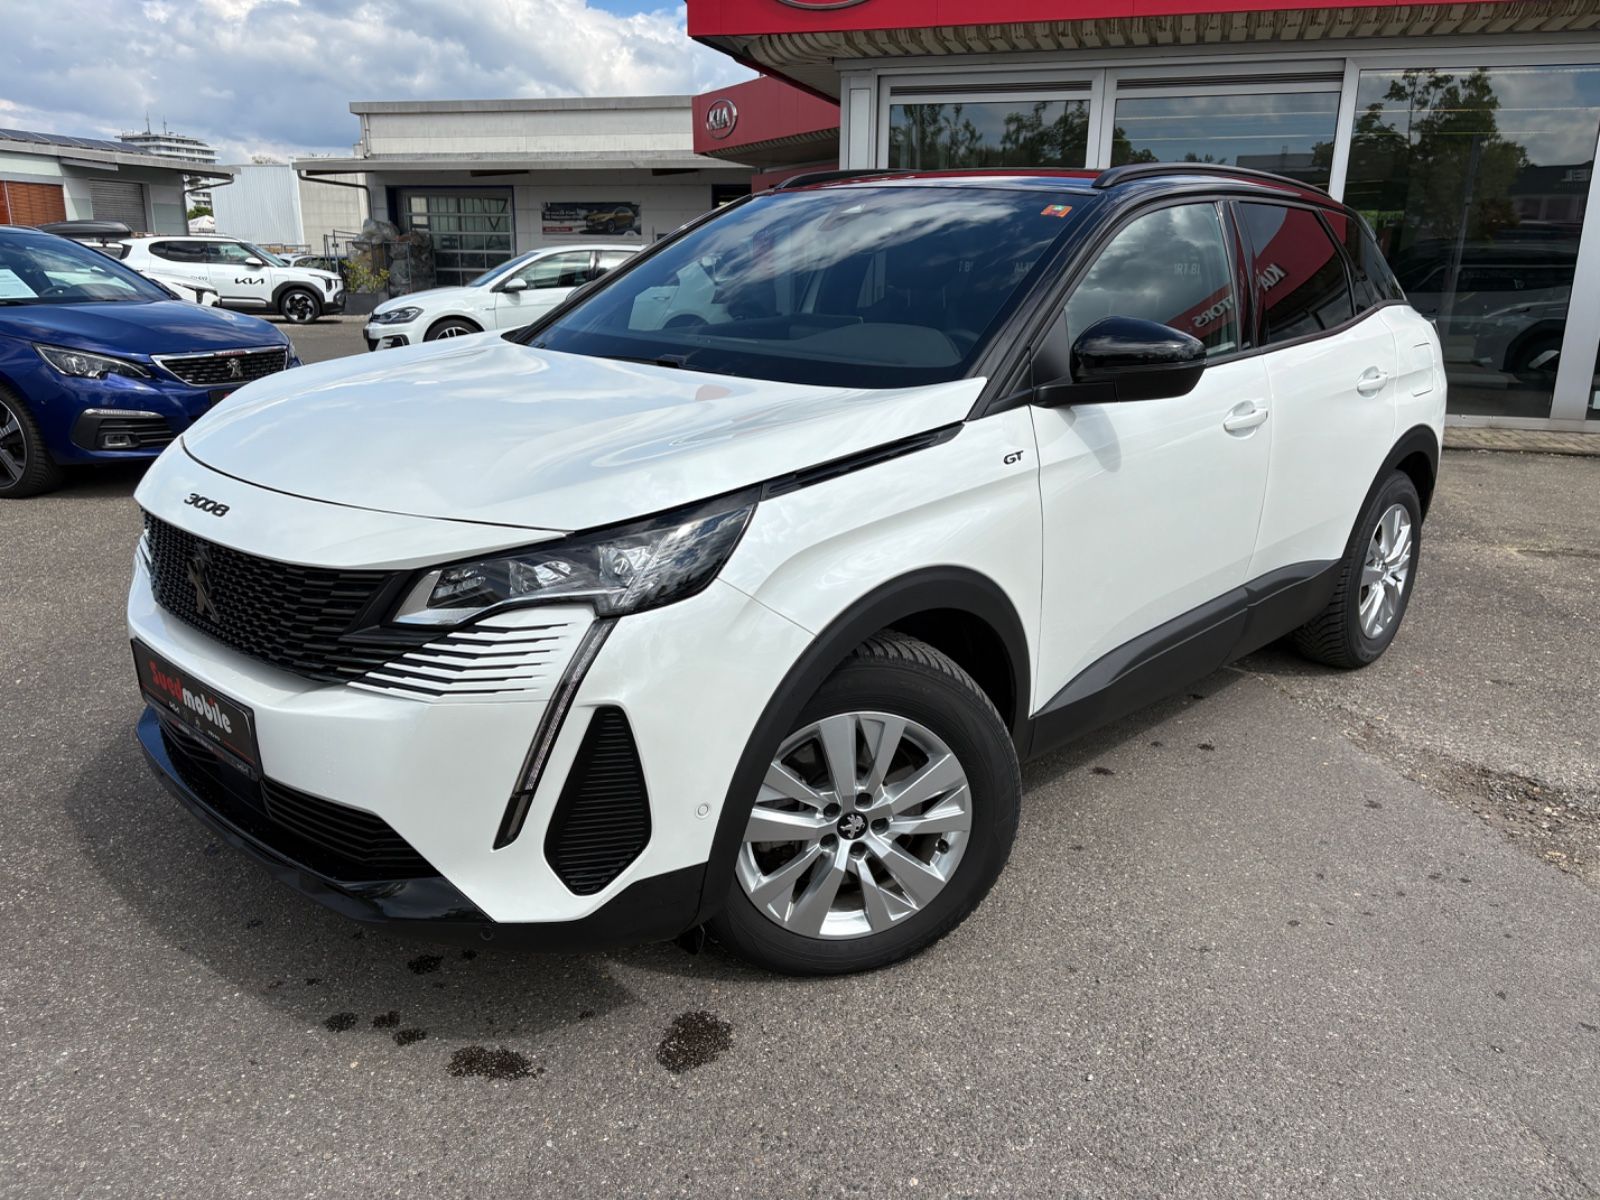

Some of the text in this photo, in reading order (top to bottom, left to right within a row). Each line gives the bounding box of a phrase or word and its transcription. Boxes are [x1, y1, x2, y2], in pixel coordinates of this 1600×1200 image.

[708, 106, 731, 130] KIA
[234, 277, 265, 285] KIA
[1003, 449, 1024, 465] GT
[183, 493, 230, 517] 3008
[149, 660, 233, 734] Suedmobile
